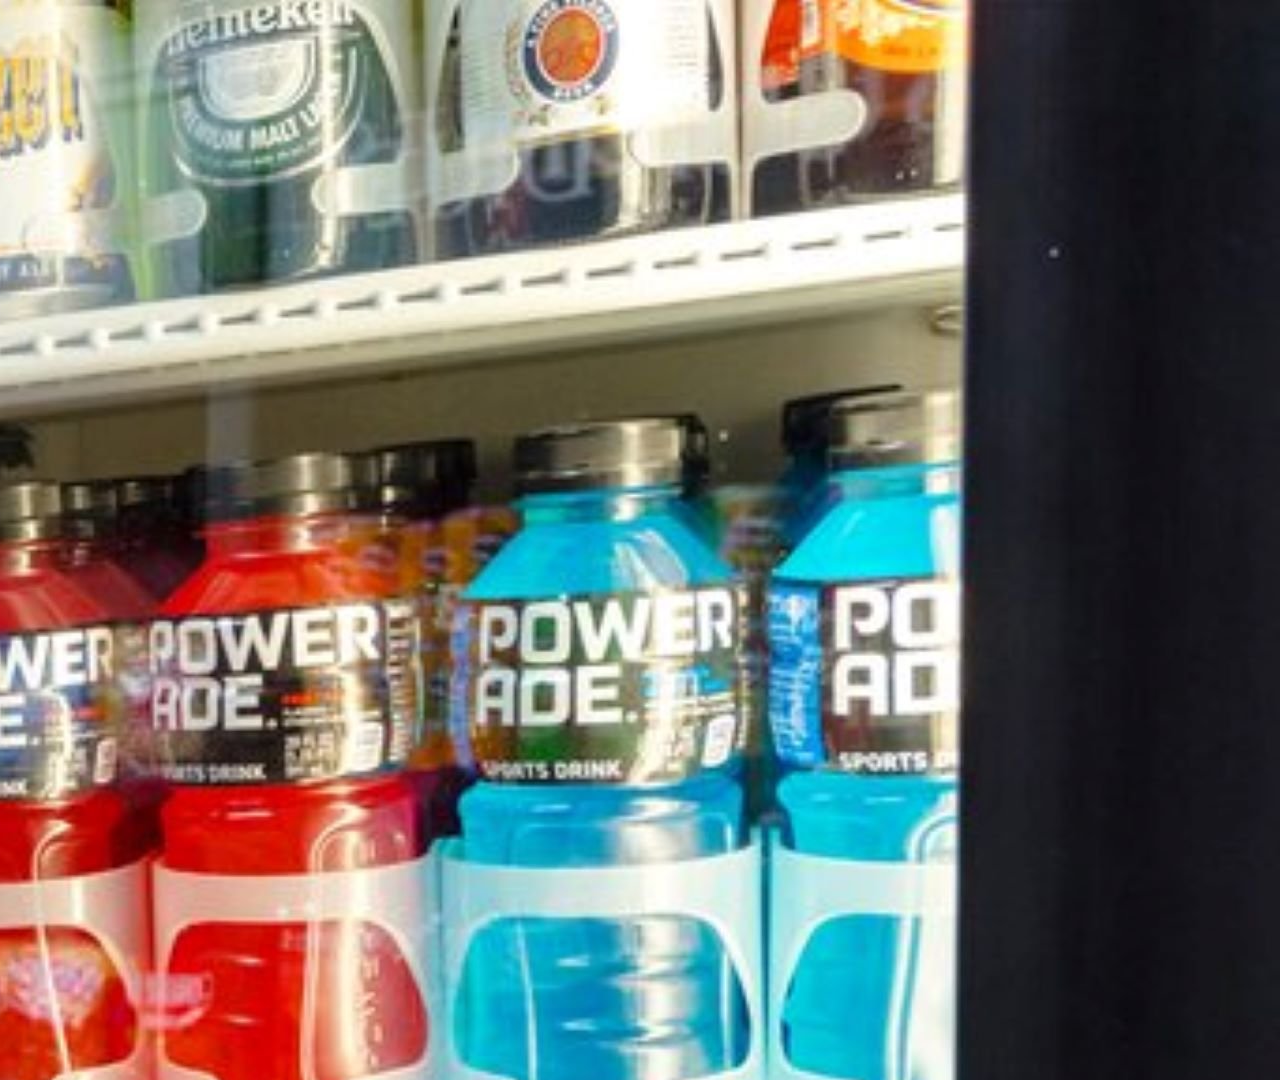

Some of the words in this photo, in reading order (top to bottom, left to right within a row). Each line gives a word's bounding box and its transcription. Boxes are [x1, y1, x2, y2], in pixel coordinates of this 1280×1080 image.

[479, 589, 734, 664] POWER
[148, 604, 382, 675] POWER
[554, 759, 624, 779] DRINK
[839, 751, 927, 771] SPORTS
[208, 762, 267, 783] DRINK
